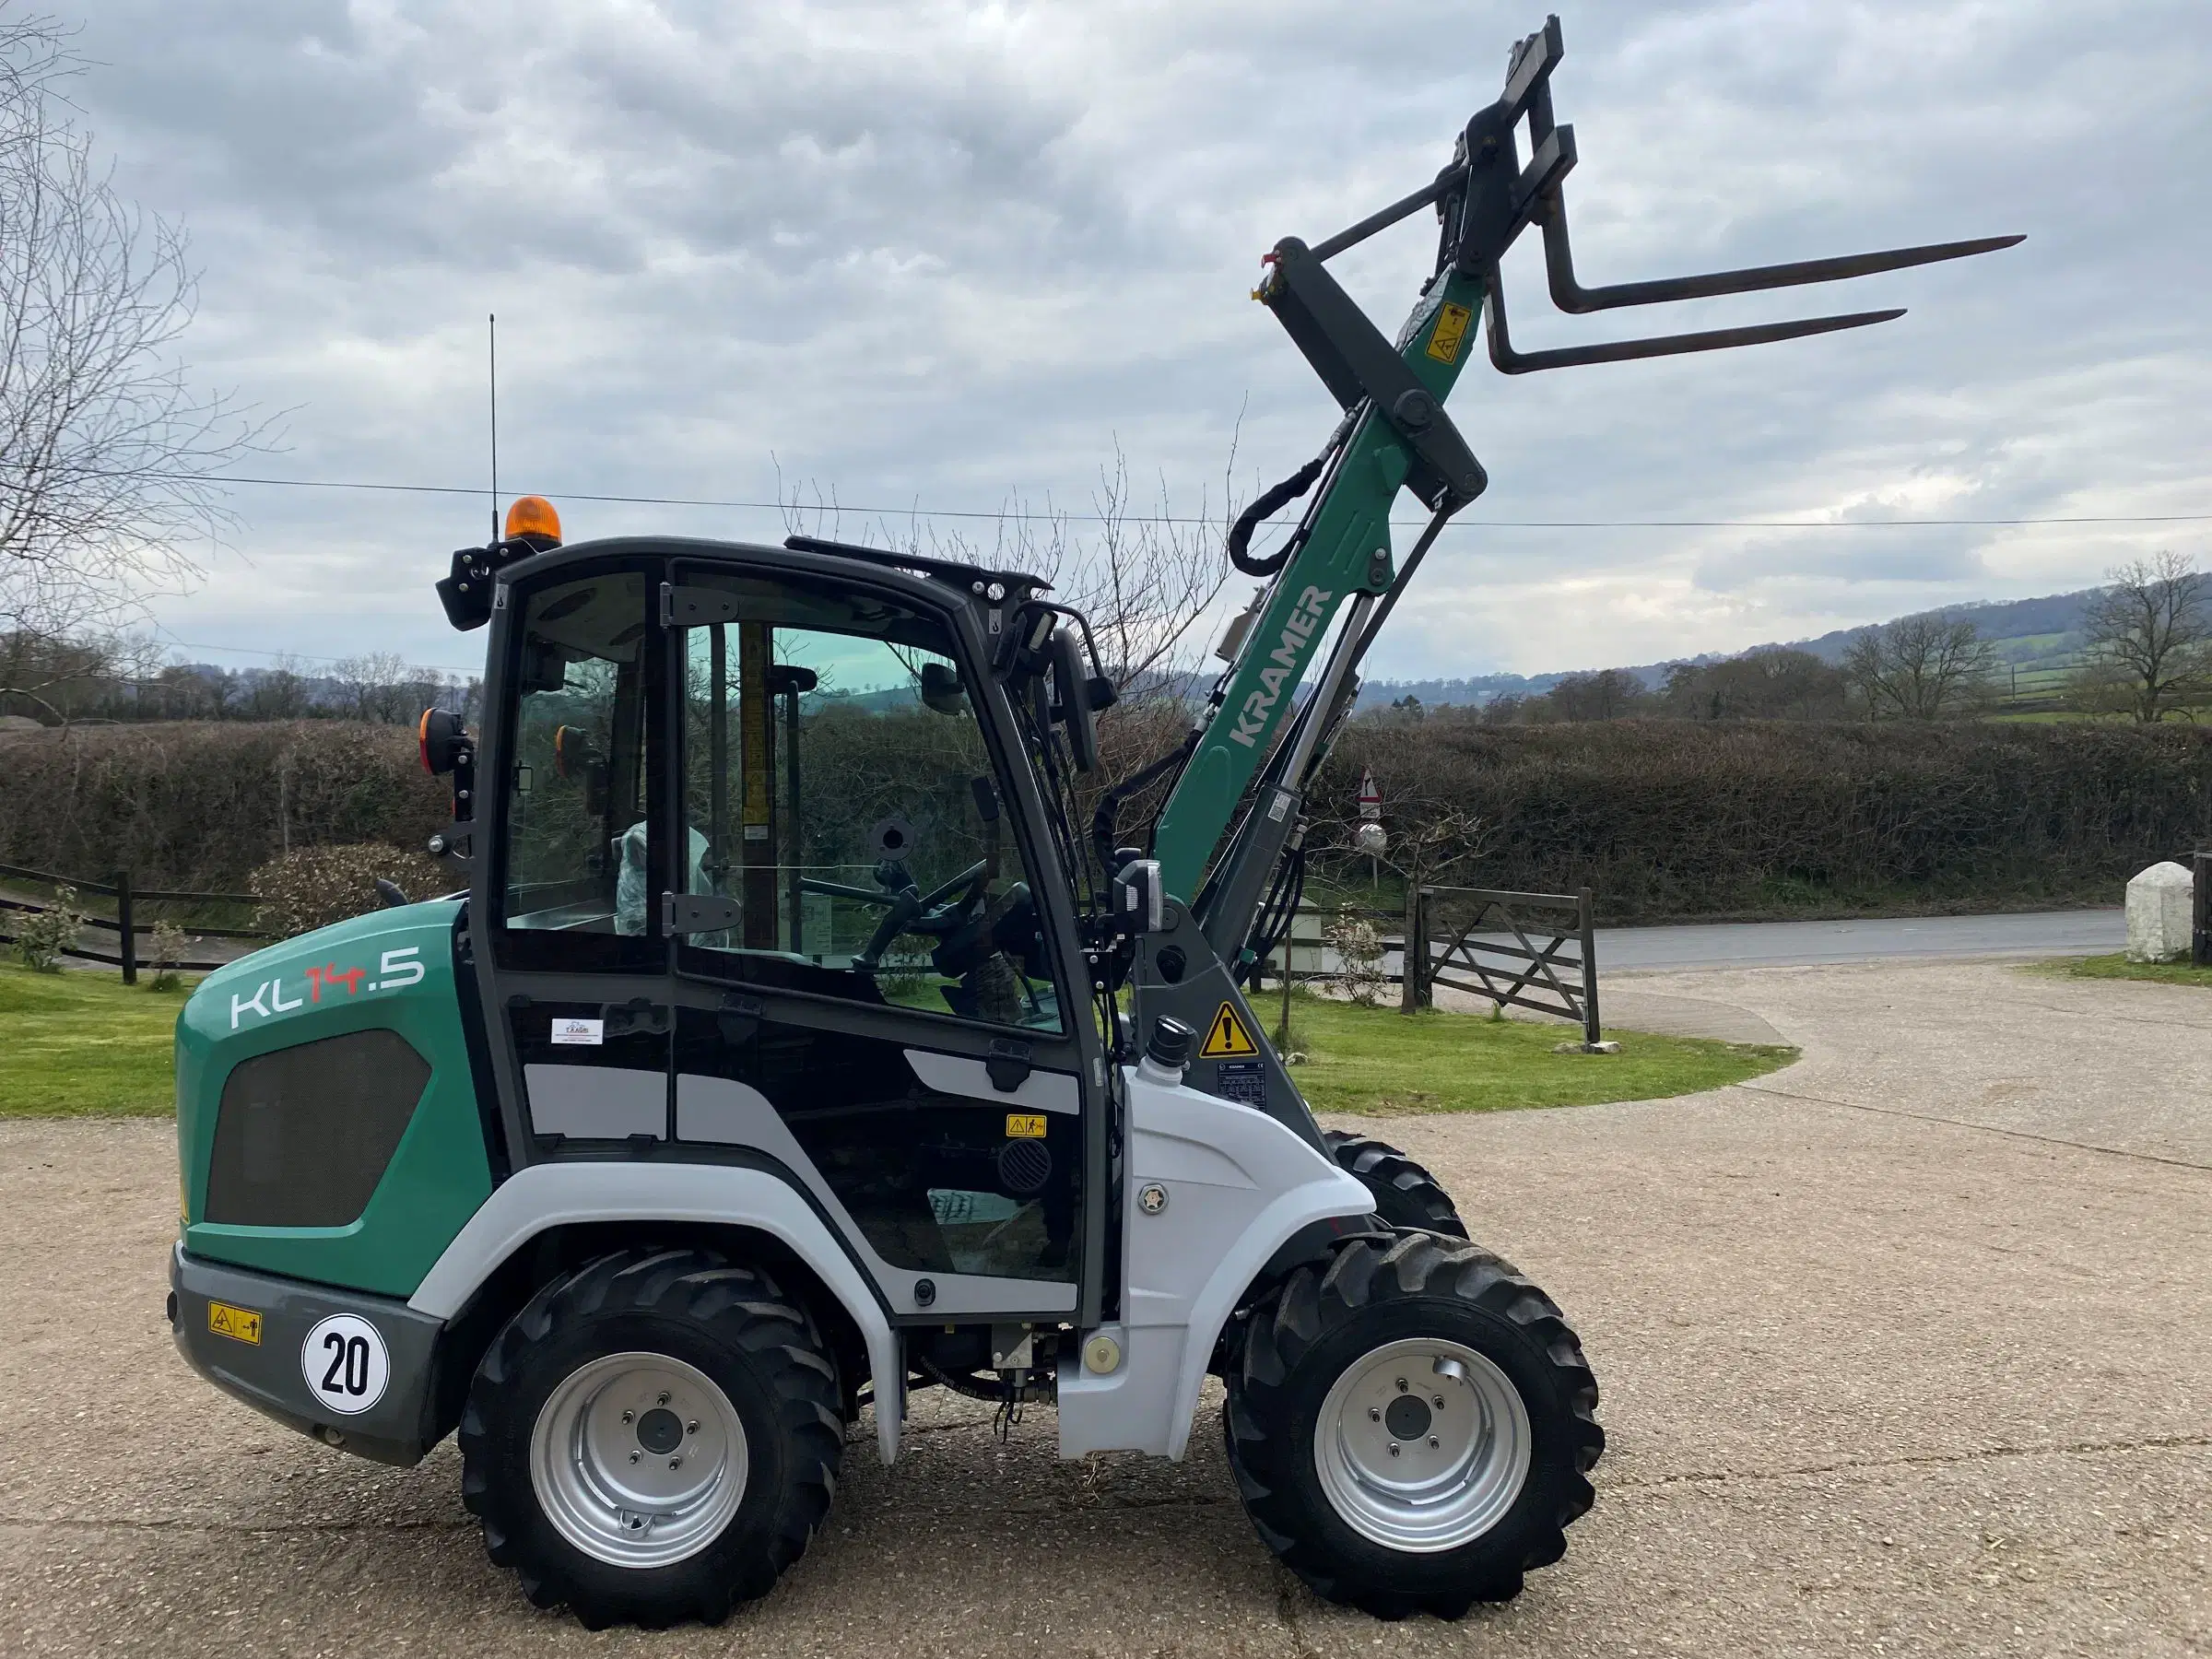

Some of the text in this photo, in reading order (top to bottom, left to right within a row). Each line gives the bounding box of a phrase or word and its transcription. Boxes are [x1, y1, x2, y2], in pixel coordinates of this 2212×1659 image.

[1229, 585, 1333, 748] KRAMER
[231, 947, 425, 1030] KL14.5
[322, 1332, 370, 1396] 20
